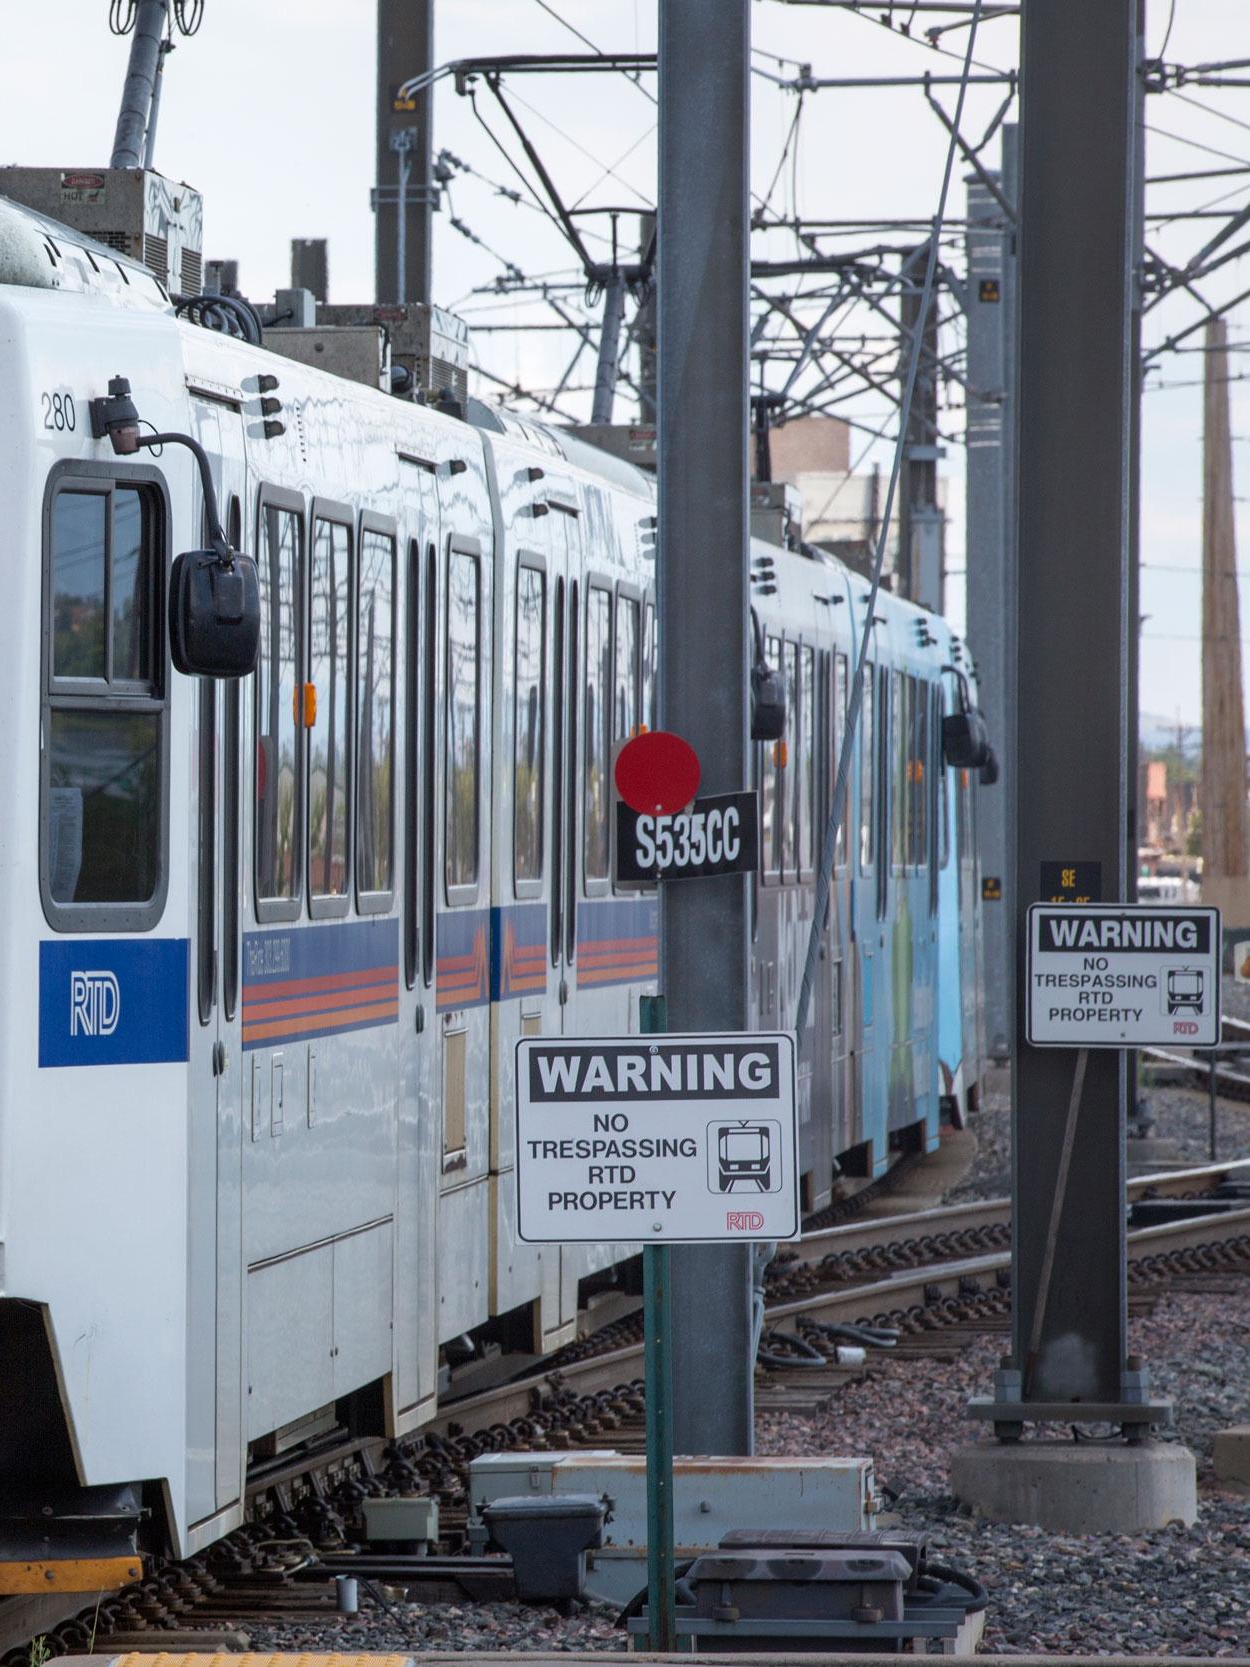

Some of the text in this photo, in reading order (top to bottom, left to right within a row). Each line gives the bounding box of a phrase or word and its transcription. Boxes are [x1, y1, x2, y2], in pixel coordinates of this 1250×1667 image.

[62, 191, 83, 201] HOT
[41, 391, 76, 432] 280
[635, 806, 741, 868] S535CC
[1061, 868, 1076, 888] SE
[1050, 919, 1198, 948] WARNING
[1083, 957, 1109, 971] NO
[1034, 974, 1157, 988] TRESPASSING
[70, 970, 120, 1036] RTD
[1078, 991, 1113, 1005] RTD
[1049, 1008, 1143, 1022] PROPERTY
[1173, 1021, 1199, 1035] RTD
[537, 1052, 772, 1093] WARNING
[593, 1114, 629, 1133] NO
[527, 1138, 697, 1159] TRESPASSING
[588, 1166, 636, 1185] RTD
[548, 1191, 676, 1211] PROPERTY
[727, 1212, 764, 1231] RTD
